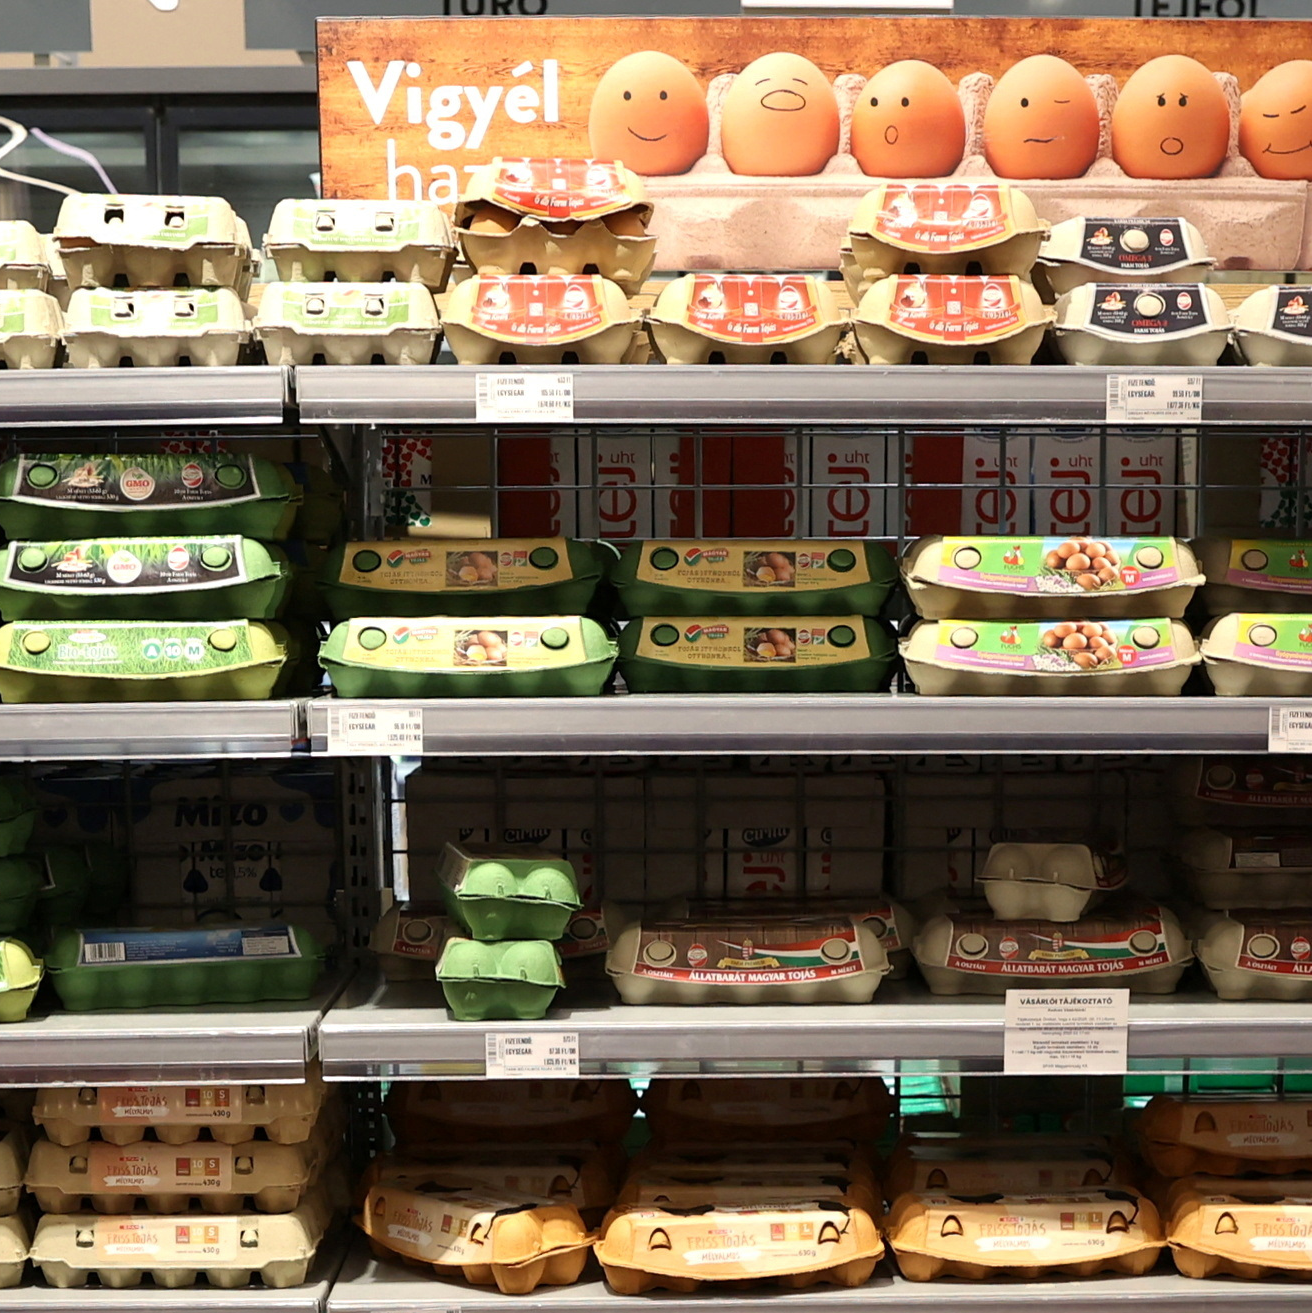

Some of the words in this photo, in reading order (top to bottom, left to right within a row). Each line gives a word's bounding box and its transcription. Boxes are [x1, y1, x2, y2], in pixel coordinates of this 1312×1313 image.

[346, 59, 560, 150] Vigyél
[1125, 575, 1135, 583] M
[1001, 962, 1057, 973] ÁLLATBARÁT
[1059, 964, 1095, 973] MAGYAR
[1097, 961, 1124, 973] TOJÁS
[689, 972, 746, 982] ÁLLATBARÁT
[748, 972, 786, 981] MAGYAR
[788, 970, 816, 980] TOJÁS
[1060, 997, 1113, 1005] TÁJÉKOZTATÓ
[687, 1237, 717, 1250] FRISS
